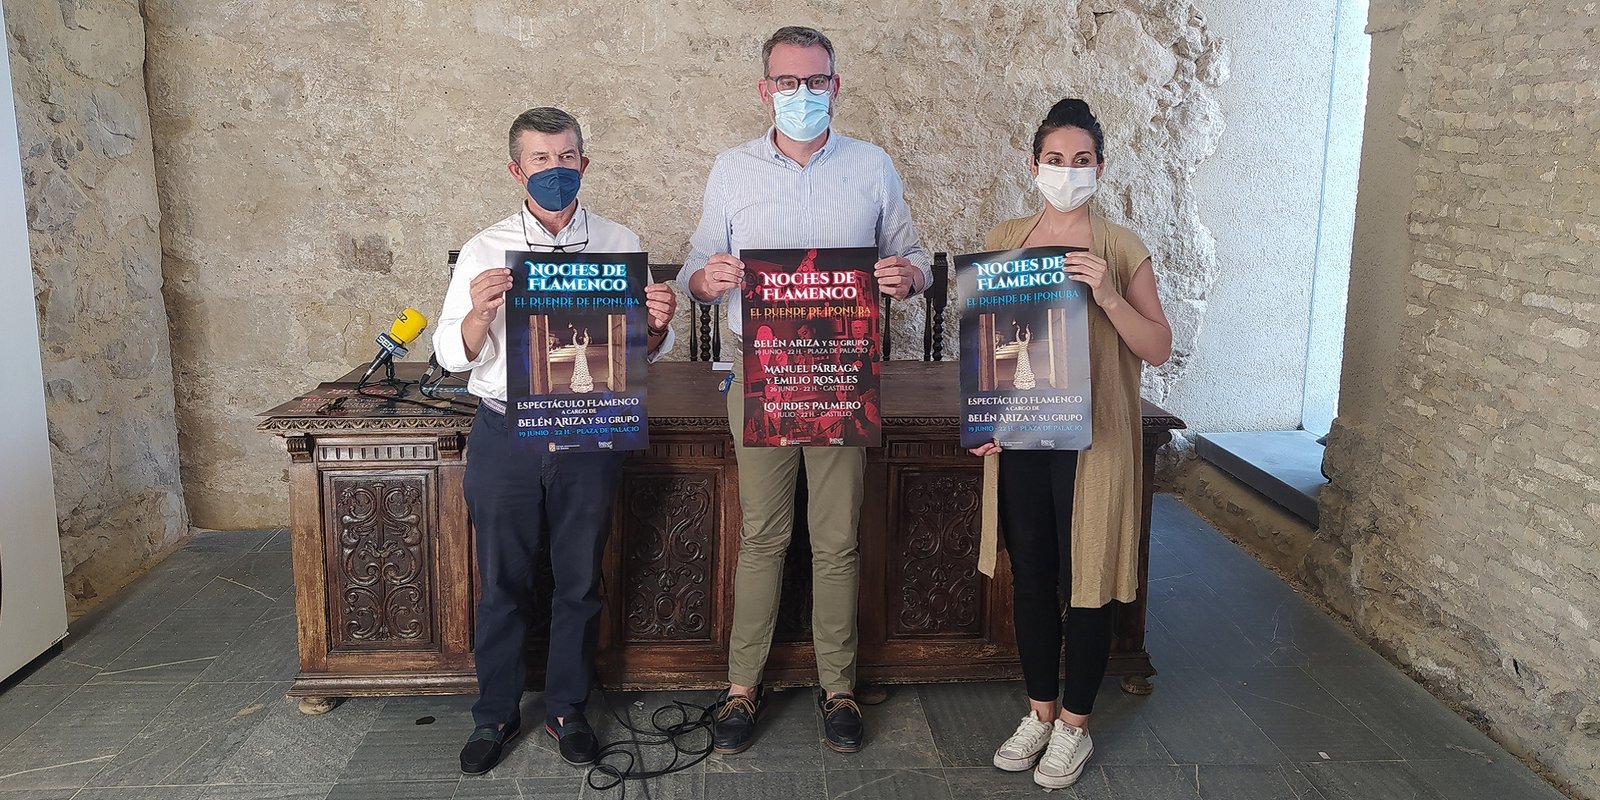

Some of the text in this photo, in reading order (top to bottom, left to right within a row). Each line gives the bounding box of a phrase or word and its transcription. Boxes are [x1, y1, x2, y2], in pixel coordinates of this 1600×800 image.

[525, 262, 626, 277] NOCHES DE
[973, 256, 1064, 276] NOCHES DE
[528, 278, 627, 291] FLAMENCO
[759, 271, 856, 287] NOCHES DE
[977, 271, 1065, 290] FLAMENCO
[763, 286, 857, 300] FLAMENCO
[966, 289, 1079, 306] EL DUENDE DE IPONUBA
[515, 297, 639, 306] EL DUENDE DE IPONUBA
[750, 305, 871, 316] EL DUENDE DE IPONUBA
[754, 338, 786, 348] BELÉN
[788, 339, 820, 347] ARIZA
[840, 339, 869, 347] GRUPO
[764, 363, 859, 374] MANUEL PÁRRAGA
[774, 376, 811, 384] EMILIO
[813, 375, 858, 385] ROSALES
[517, 398, 639, 410] ESPECTÁCULO FLAMENCO
[764, 401, 861, 412] LOURDES PALMERO
[968, 396, 1083, 405] ESPECTÁCULO FLAMENCO
[518, 417, 553, 427] BELÉN
[554, 416, 586, 427] ARIZA
[608, 415, 639, 424] GRUPO
[968, 413, 997, 423] BELÉN
[999, 413, 1030, 423] ARIZA
[1051, 413, 1083, 421] GRUPO
